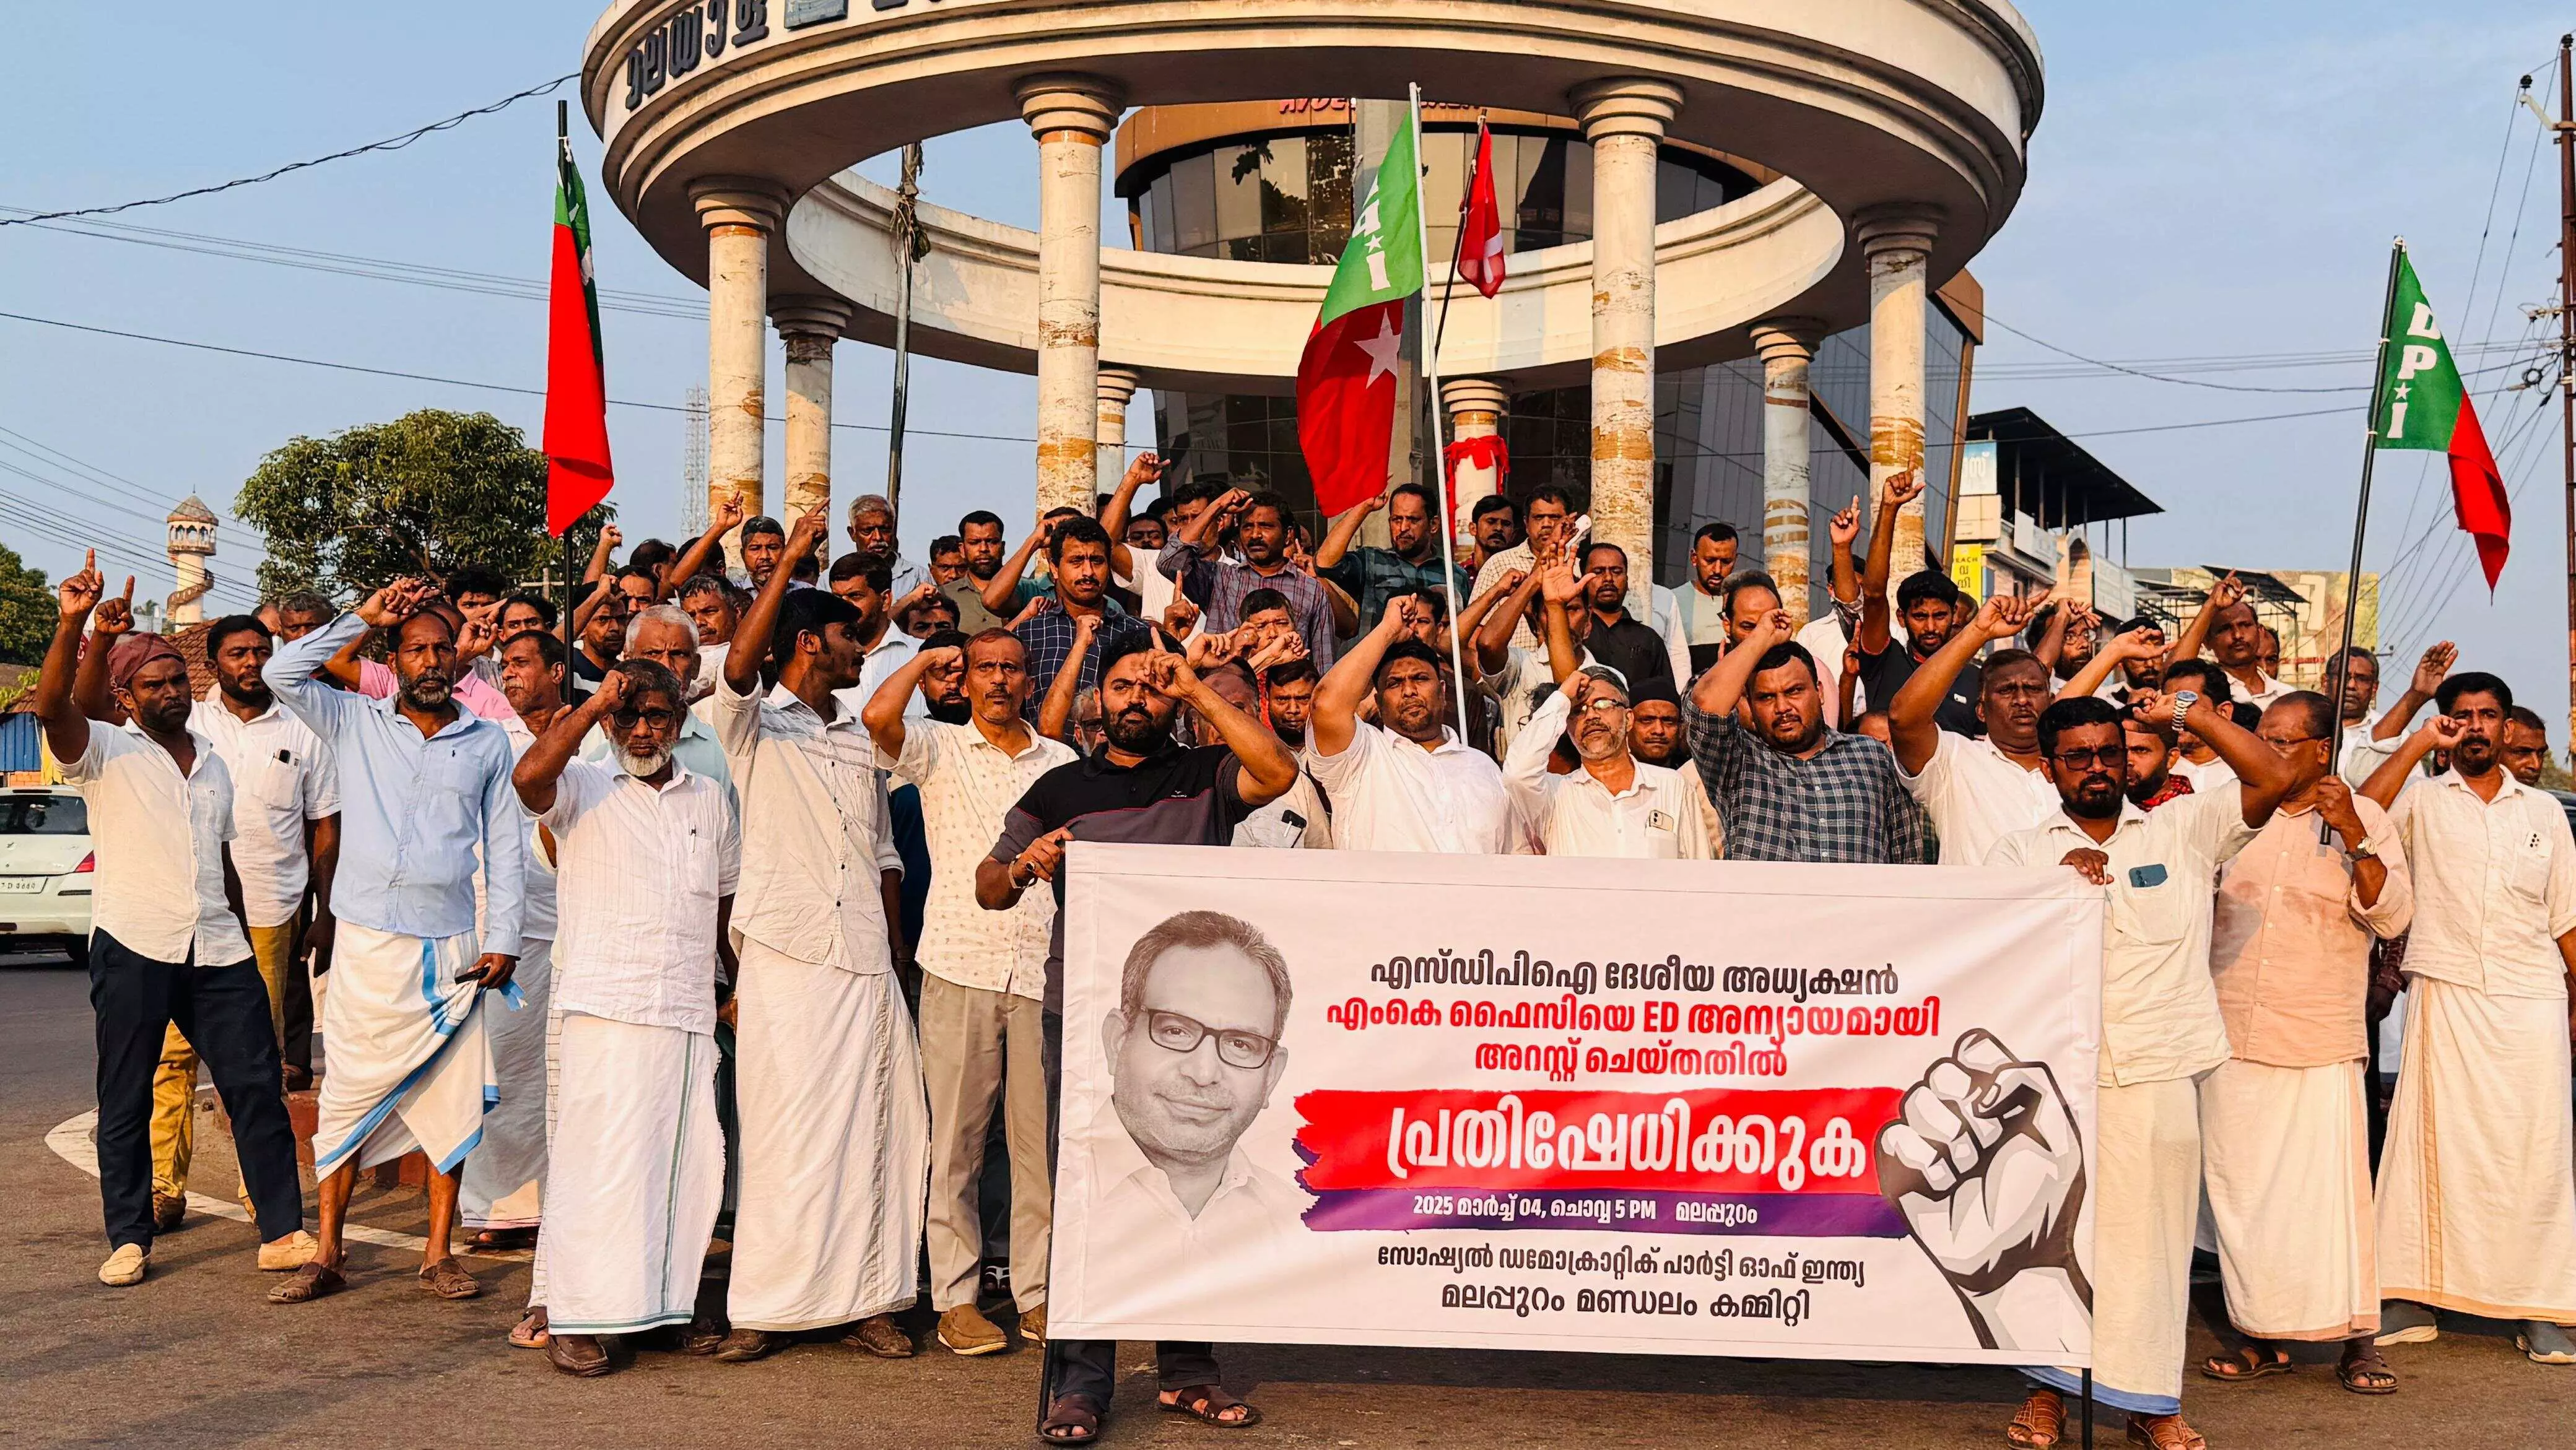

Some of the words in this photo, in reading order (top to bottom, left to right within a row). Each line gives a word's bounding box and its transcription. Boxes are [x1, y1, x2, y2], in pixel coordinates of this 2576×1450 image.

[1372, 949, 1597, 995] എസ്ഡിപിഐ
[1605, 955, 1714, 992] ദേശീയ
[1723, 963, 1899, 1003] അധ്യക്ഷൻ
[1326, 997, 1442, 1030] എംകെ
[1450, 993, 1635, 1032] ഫൈസിയെ
[1643, 1001, 1679, 1033] ED
[1688, 996, 1940, 1044] അന്യായമായി
[1476, 1037, 1582, 1082] അറസ്റ്റ്
[1586, 1040, 1787, 1076] ചെയ്തതിൽ
[1387, 1094, 1866, 1191] പ്രതിഷേധിക്കുക
[1413, 1195, 1453, 1215] 2025
[1457, 1193, 1518, 1222] മാർച്ച്
[1520, 1198, 1547, 1218] 04,
[1551, 1199, 1611, 1224] ചൊവ്വ
[1615, 1200, 1625, 1218] 5
[1630, 1200, 1656, 1220] PM
[1675, 1202, 1757, 1227] മലപ്പുറം
[1378, 1243, 1493, 1274] സോഷ്യൽ
[1500, 1244, 1661, 1280] ഡമോക്രാറ്റിക്
[1663, 1248, 1733, 1281] പാർട്ടി
[1739, 1252, 1799, 1279] ഓഫ്
[1802, 1259, 1865, 1288] ഇന്ത്യ
[1442, 1284, 1565, 1317] മലപ്പുറം
[1577, 1288, 1698, 1316] മണ്ഡലം
[1710, 1288, 1809, 1327] കമ്മിറ്റി
